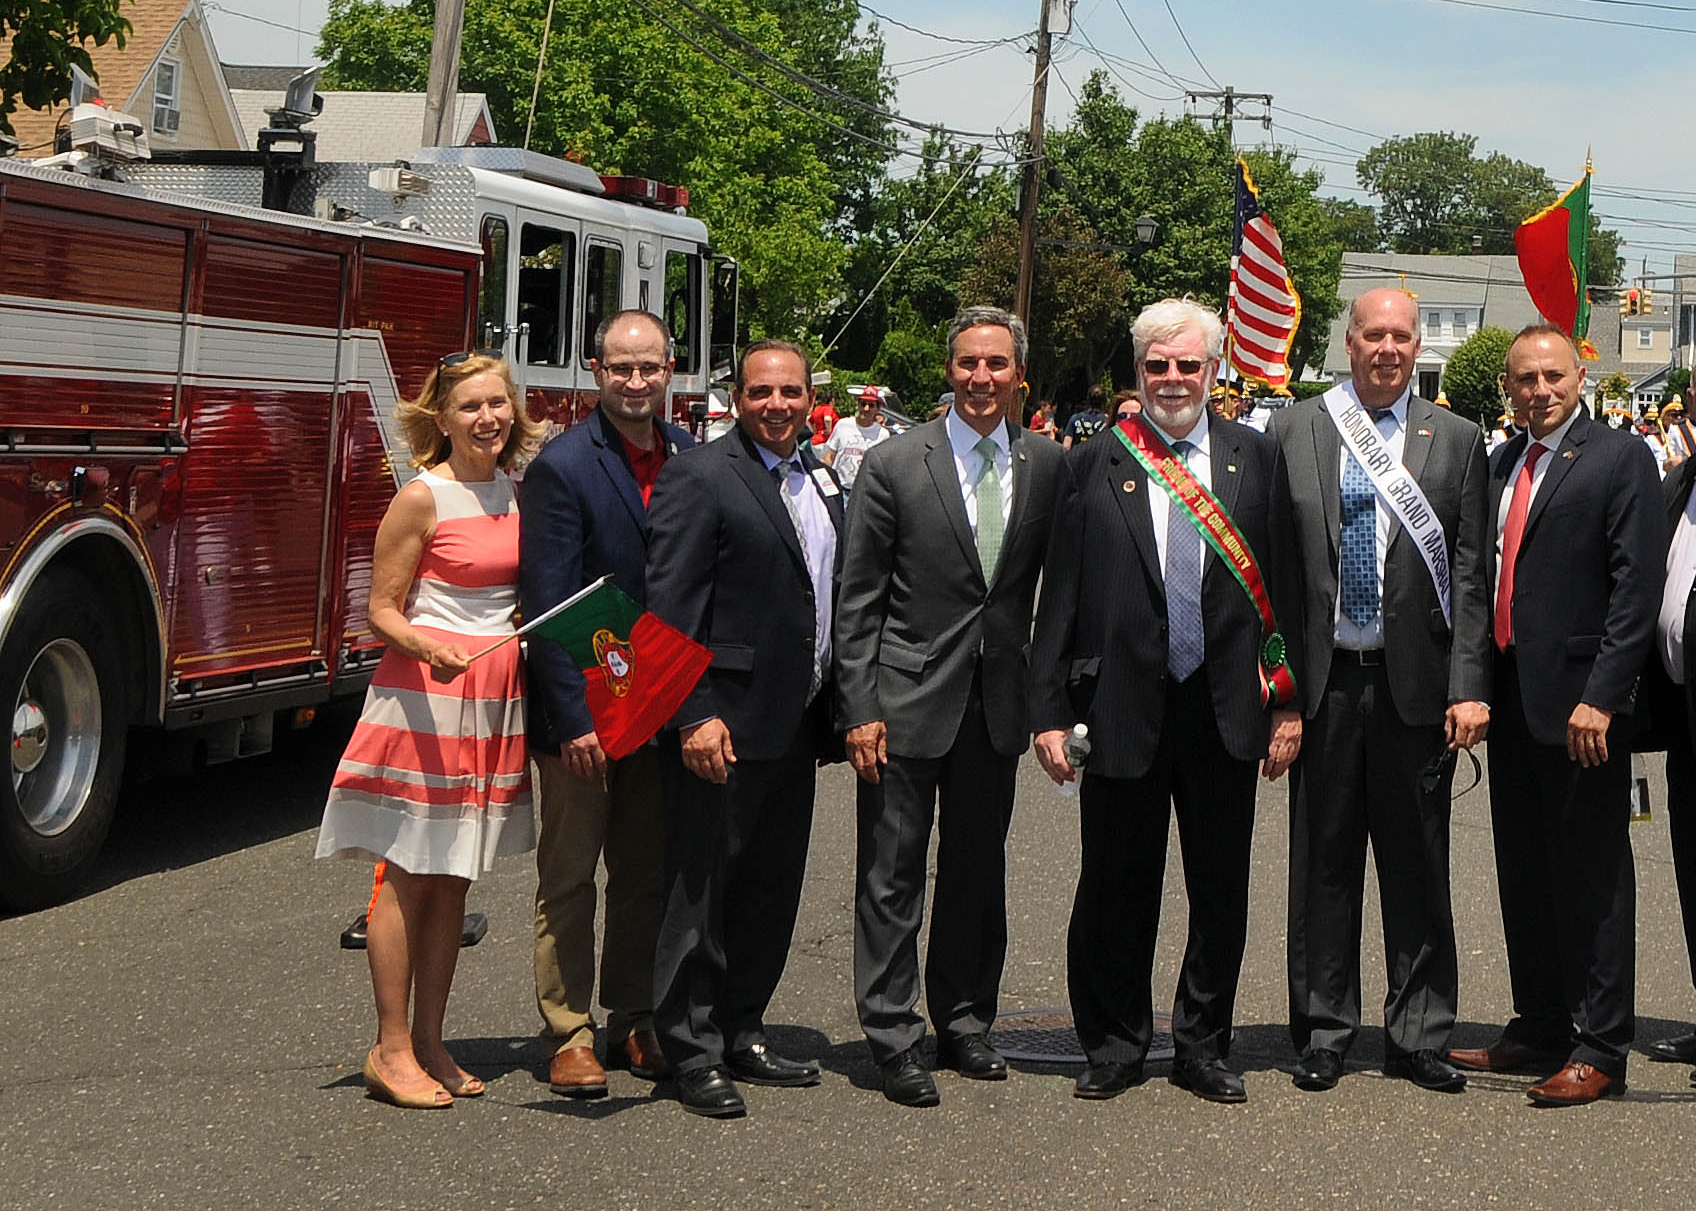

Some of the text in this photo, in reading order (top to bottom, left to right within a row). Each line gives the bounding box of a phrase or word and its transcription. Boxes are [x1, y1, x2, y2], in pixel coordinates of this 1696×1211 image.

[1161, 456, 1251, 571] FRIEND OF THE COMMUNITY
[1339, 404, 1451, 601] HONORARY GRAND MARSHAL
